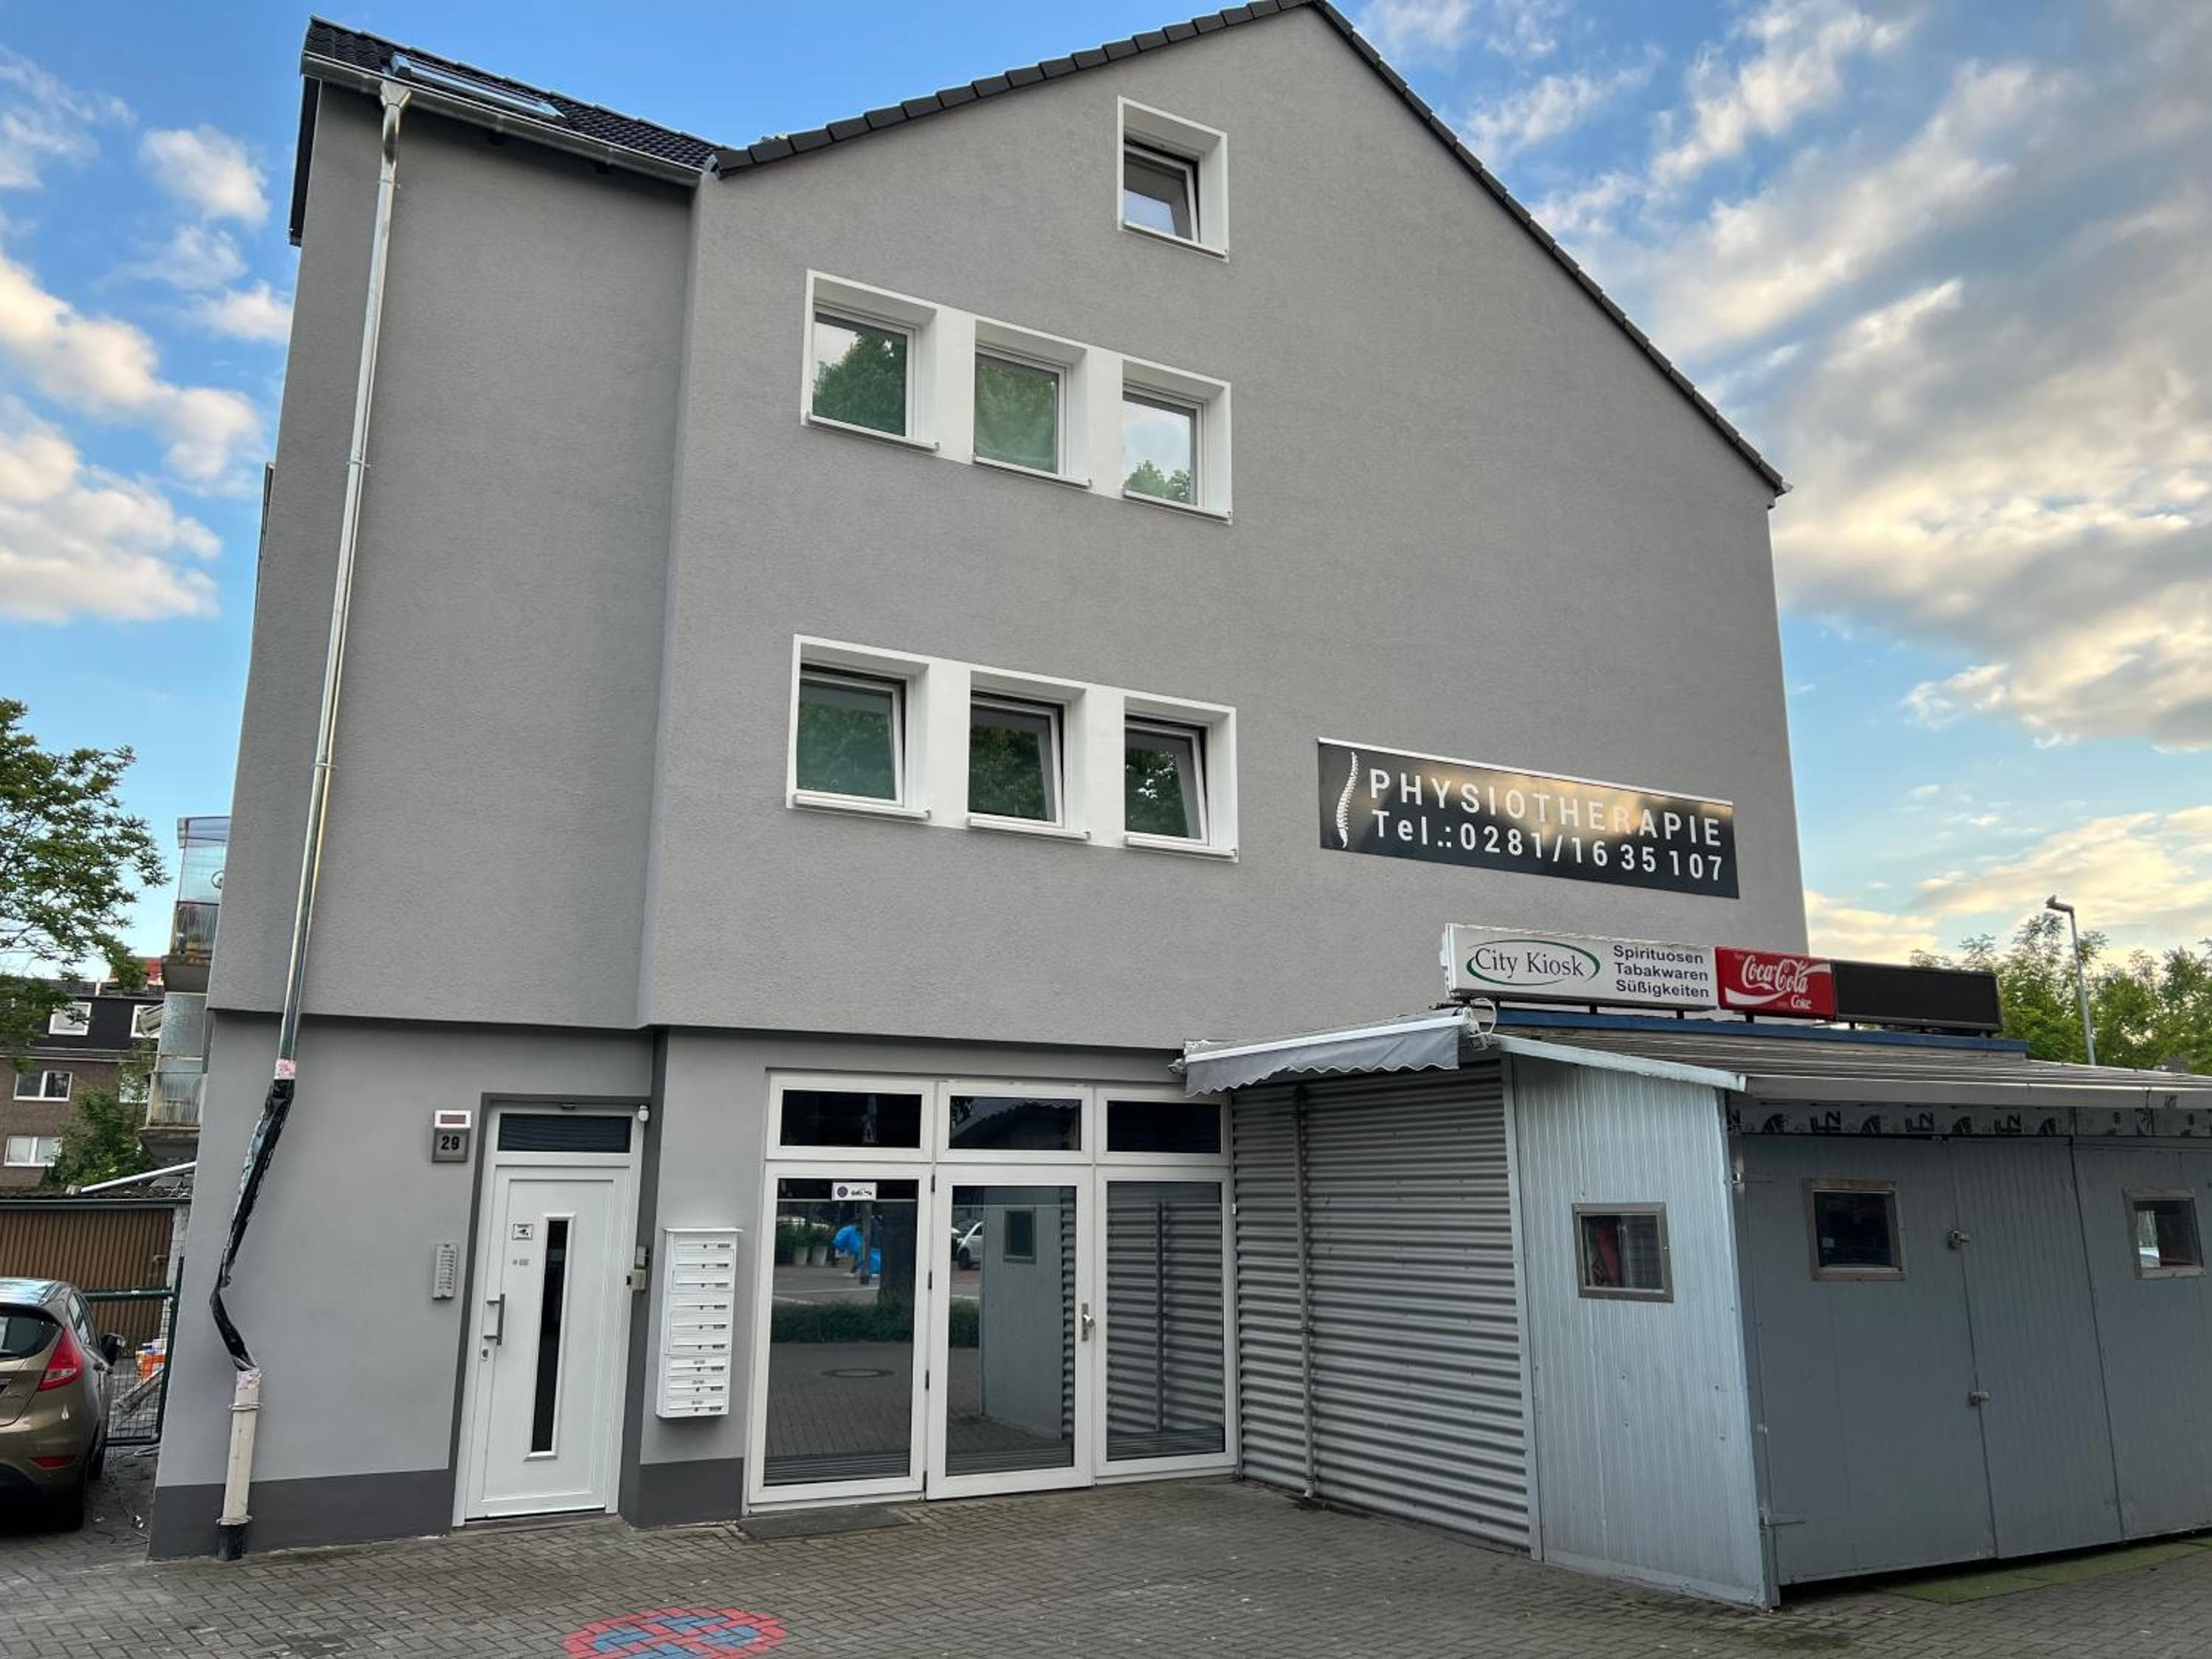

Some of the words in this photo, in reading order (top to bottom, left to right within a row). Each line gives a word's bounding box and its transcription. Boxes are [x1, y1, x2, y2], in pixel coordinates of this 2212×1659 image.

[1370, 768, 1722, 846] PHYSIOTHERAPIE
[1669, 851, 1722, 881] 107
[1475, 947, 1517, 978] City
[1526, 952, 1584, 976] Kiosk
[1613, 945, 1703, 964] Spirituosen
[1614, 962, 1708, 981] Tabakwaren
[1615, 979, 1709, 998] Süßigkeiten
[1790, 994, 1812, 1009] Coke
[441, 1135, 460, 1150] 29
